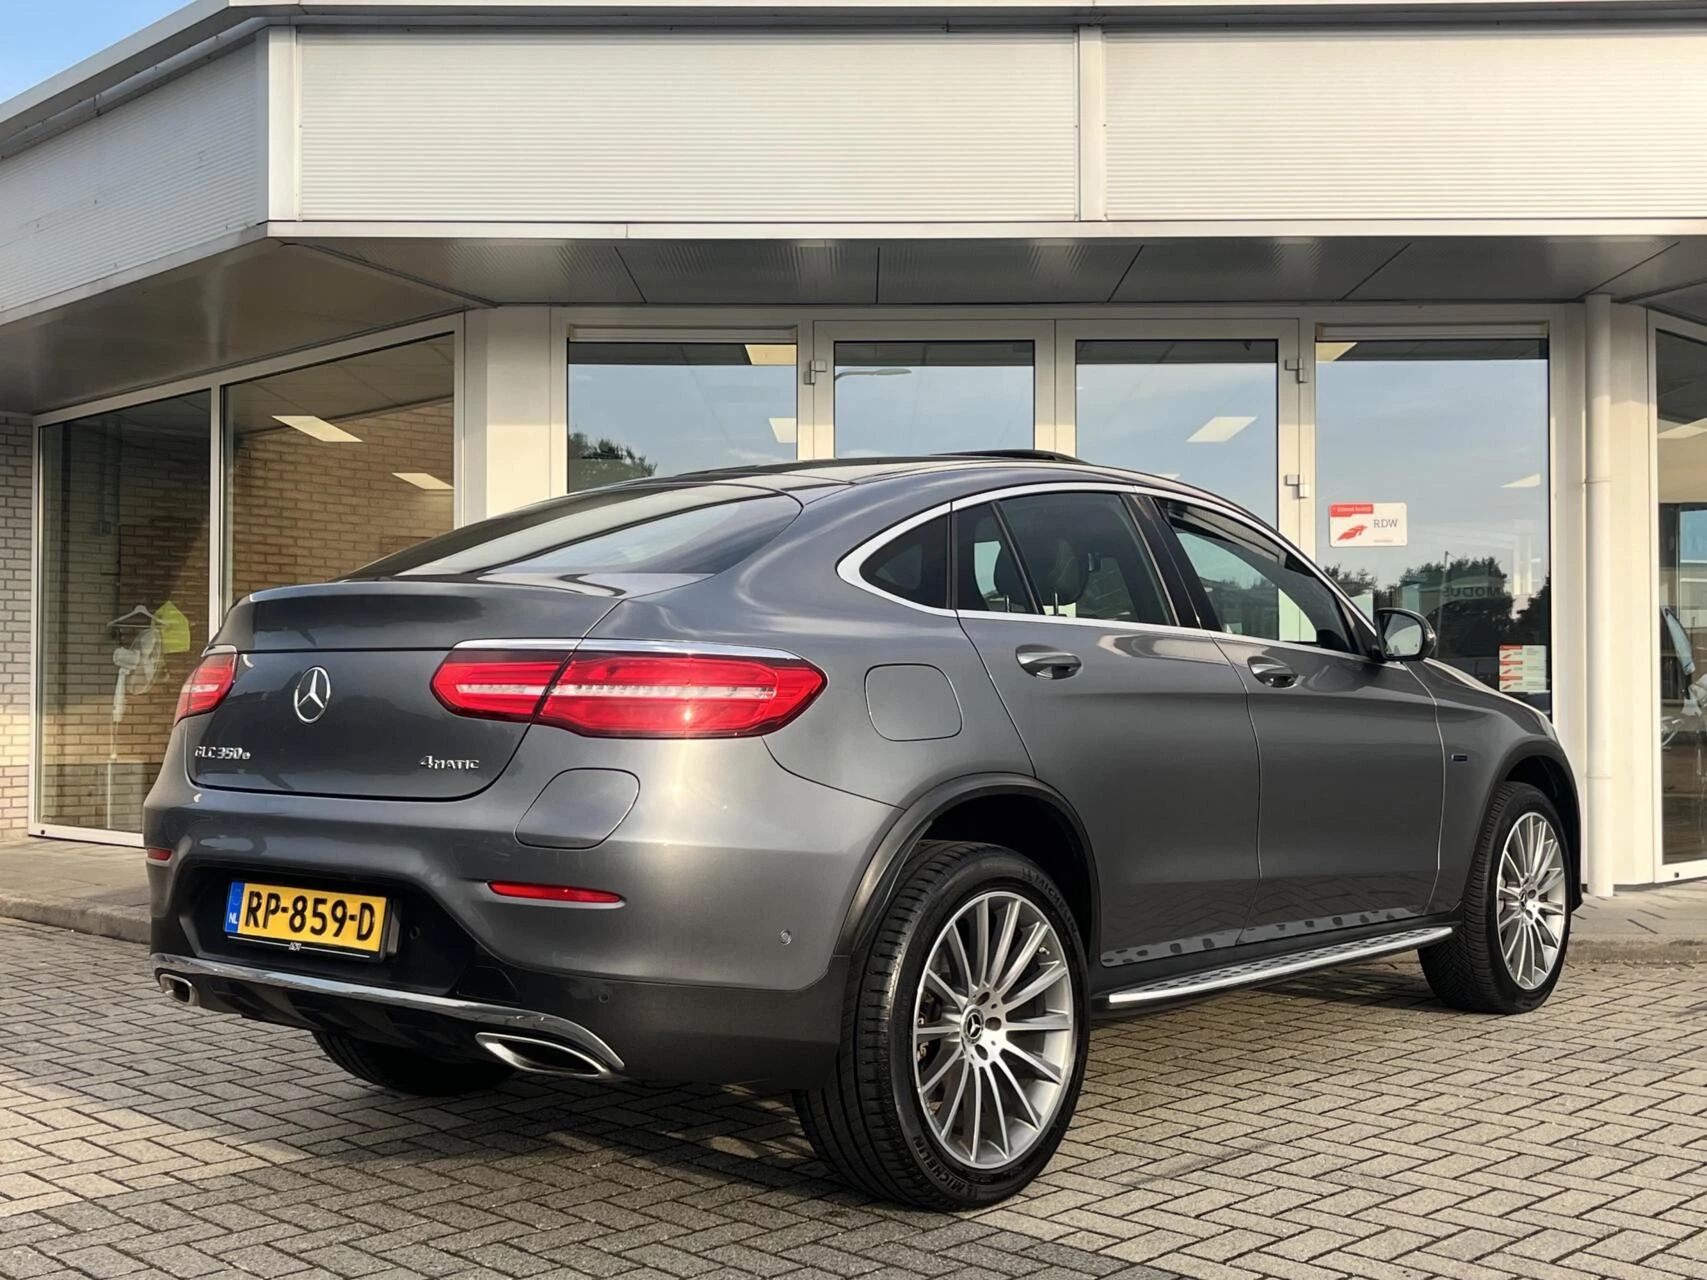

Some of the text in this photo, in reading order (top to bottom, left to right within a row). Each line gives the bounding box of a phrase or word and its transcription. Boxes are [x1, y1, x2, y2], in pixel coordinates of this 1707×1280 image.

[1373, 519, 1399, 528] RDW
[420, 755, 480, 770] 4MATIC
[228, 912, 238, 925] NL
[244, 890, 376, 942] RP-859-D
[913, 1136, 966, 1193] MICHELIN
